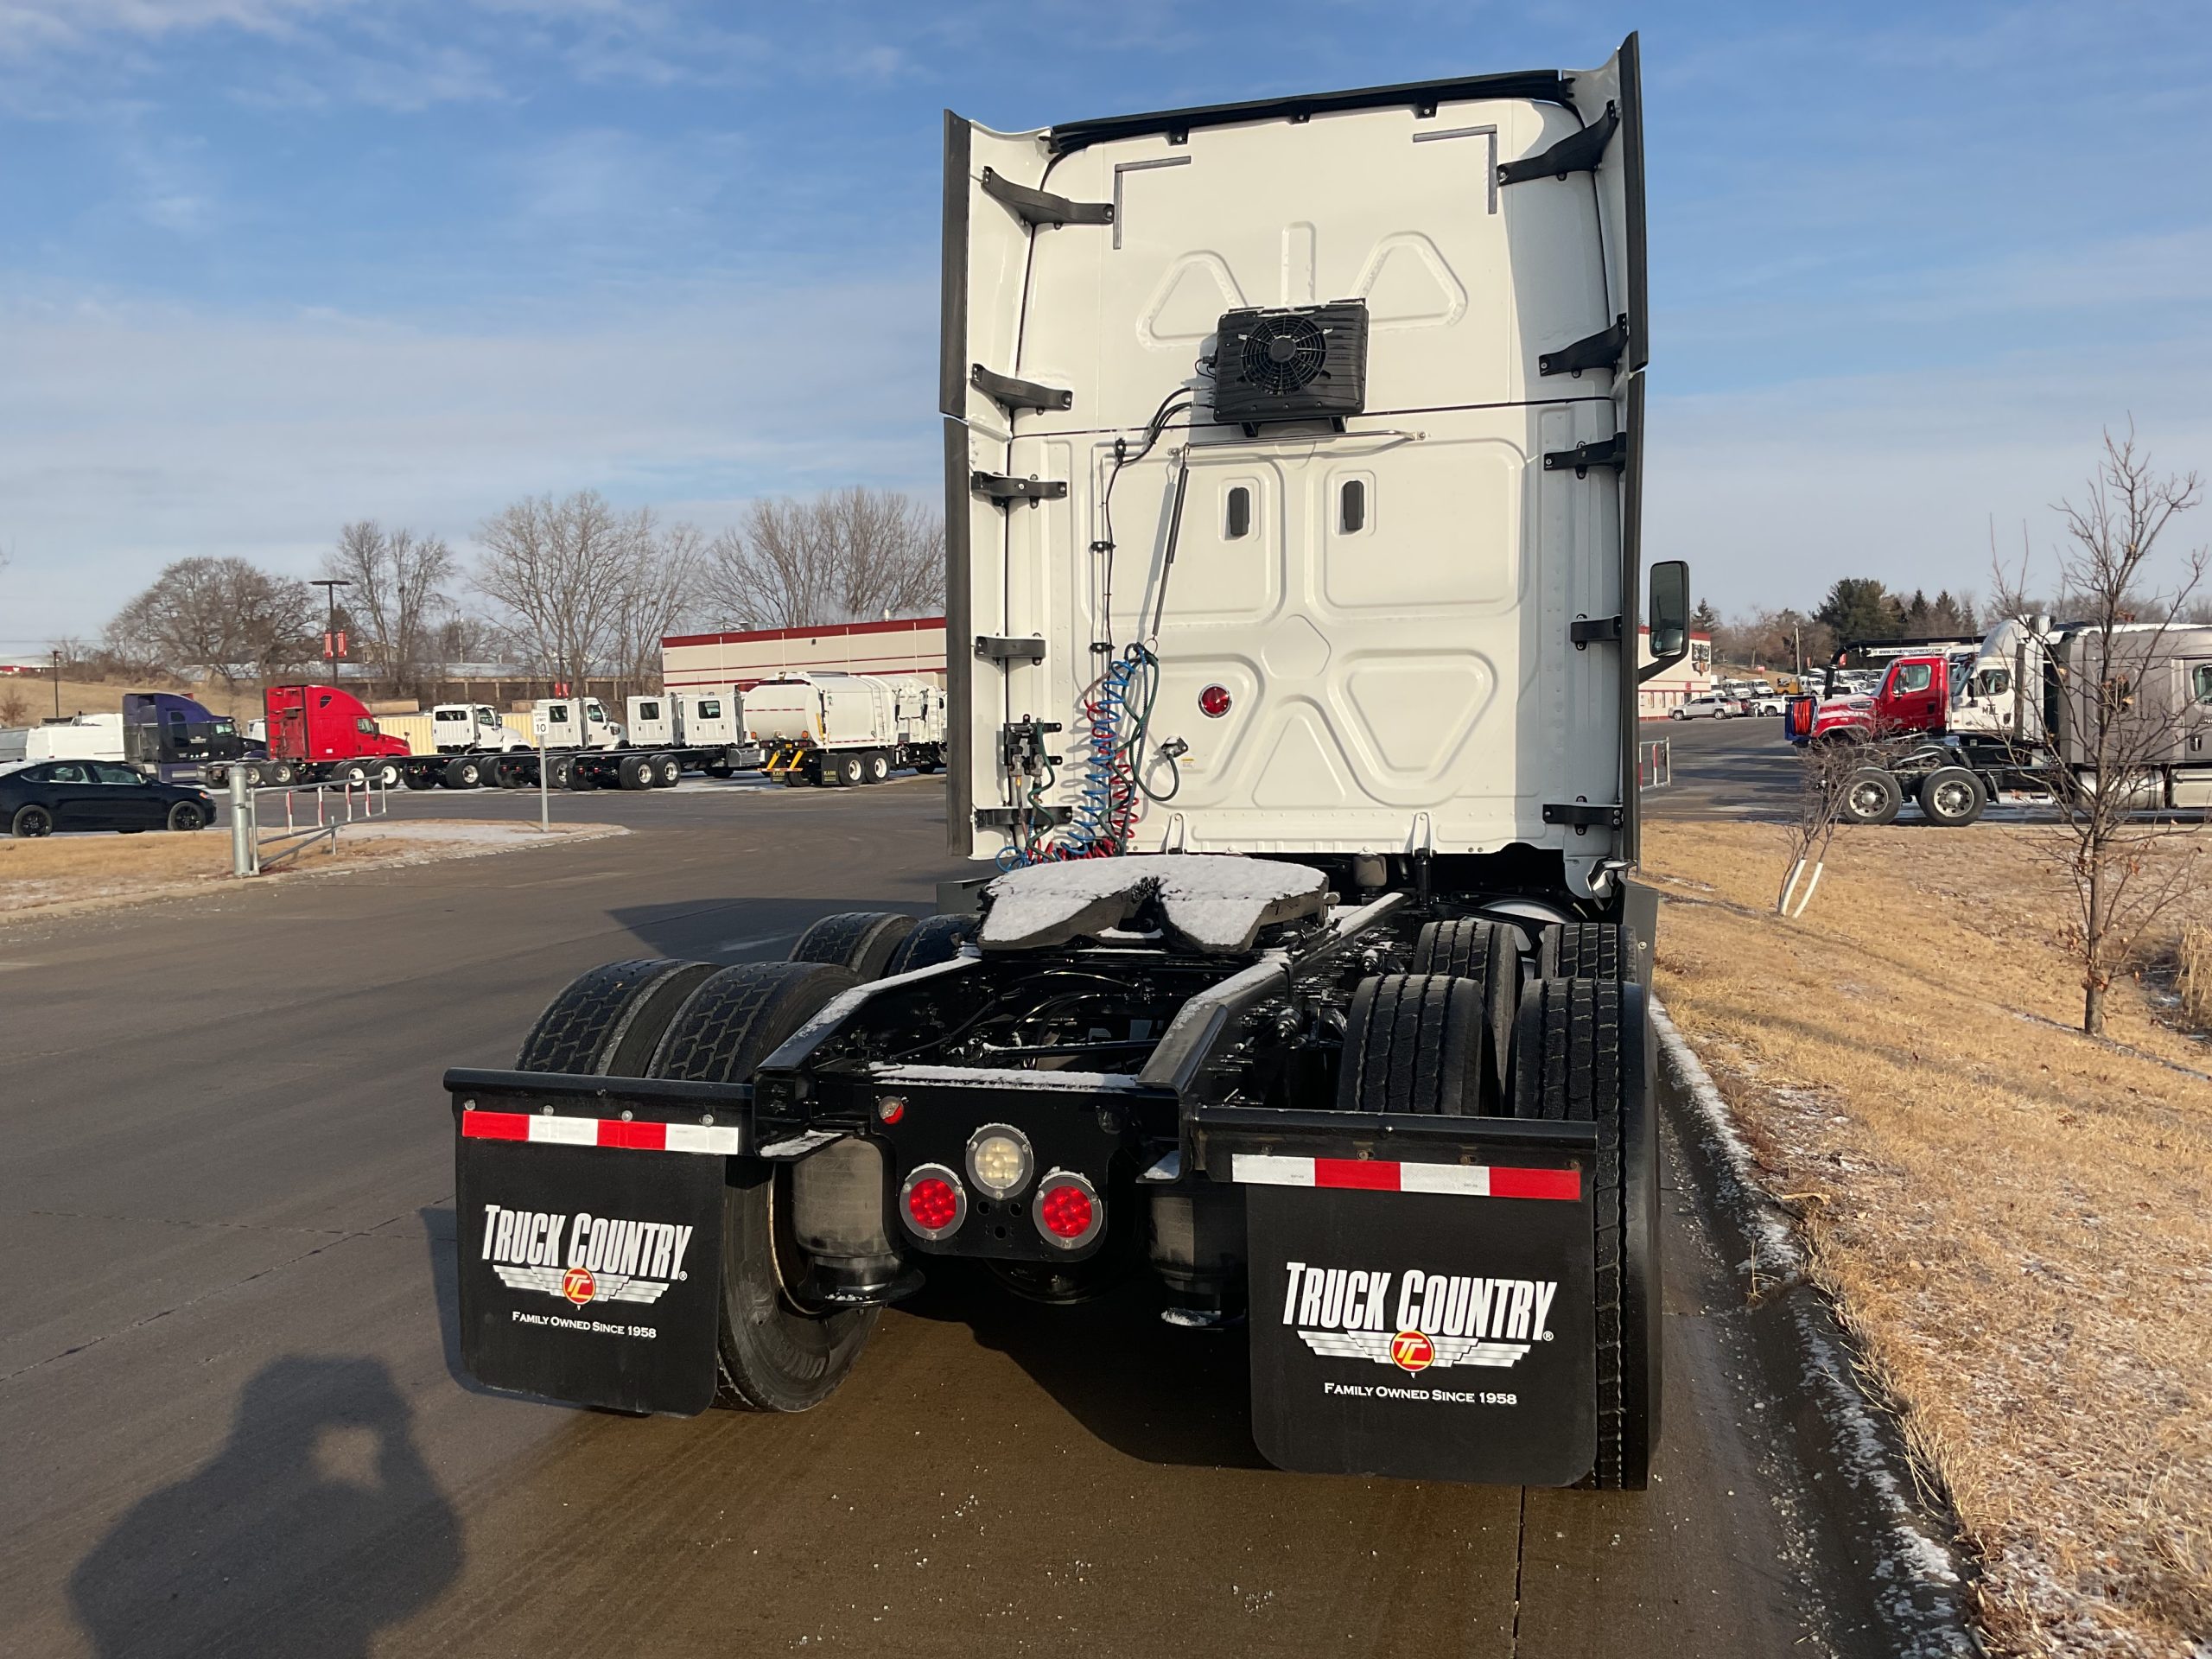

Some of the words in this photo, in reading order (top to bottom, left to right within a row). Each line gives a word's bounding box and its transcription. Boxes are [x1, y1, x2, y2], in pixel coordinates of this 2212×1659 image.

[537, 723, 546, 733] 10
[482, 1204, 567, 1268] TRUCK
[568, 1212, 694, 1281] COUNTRY
[564, 1272, 593, 1300] TC
[1282, 1262, 1392, 1331] TRUCK
[1395, 1269, 1558, 1341] COUNTRY
[512, 1311, 550, 1325] FAMILY
[550, 1316, 591, 1331] OWNED
[592, 1321, 625, 1335] SINCE
[627, 1325, 657, 1338] 1958
[1393, 1337, 1432, 1368] TC
[1324, 1382, 1374, 1397] FAMILY
[1376, 1386, 1429, 1401] OWNED
[1432, 1389, 1474, 1403] SINCE
[1479, 1392, 1517, 1405] 1958
